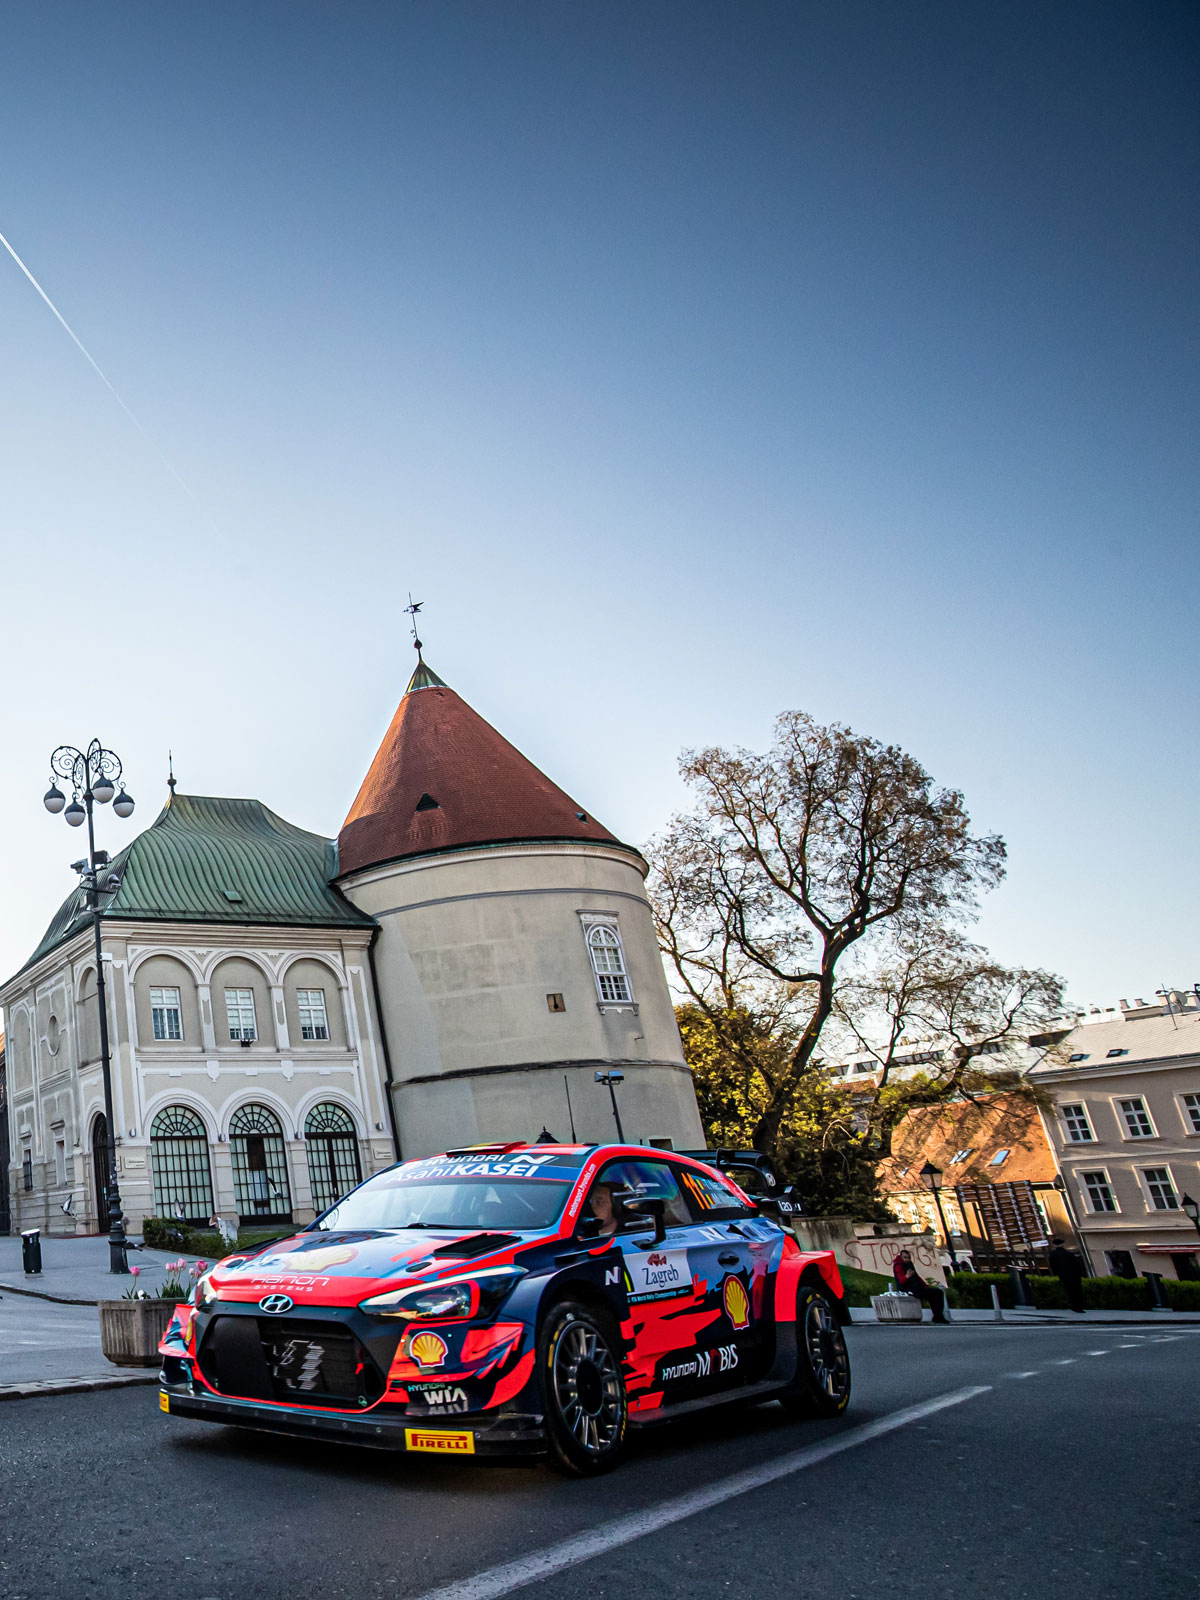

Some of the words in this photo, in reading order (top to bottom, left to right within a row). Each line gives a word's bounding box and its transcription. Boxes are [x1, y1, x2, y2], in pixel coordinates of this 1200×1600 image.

[605, 1266, 620, 1286] N
[642, 1264, 679, 1288] Zagreb
[662, 1361, 697, 1381] HYUNDAI
[696, 1343, 739, 1377] MOBIS
[407, 1382, 446, 1392] HYUNDAI
[411, 1433, 468, 1449] PIRELLI
